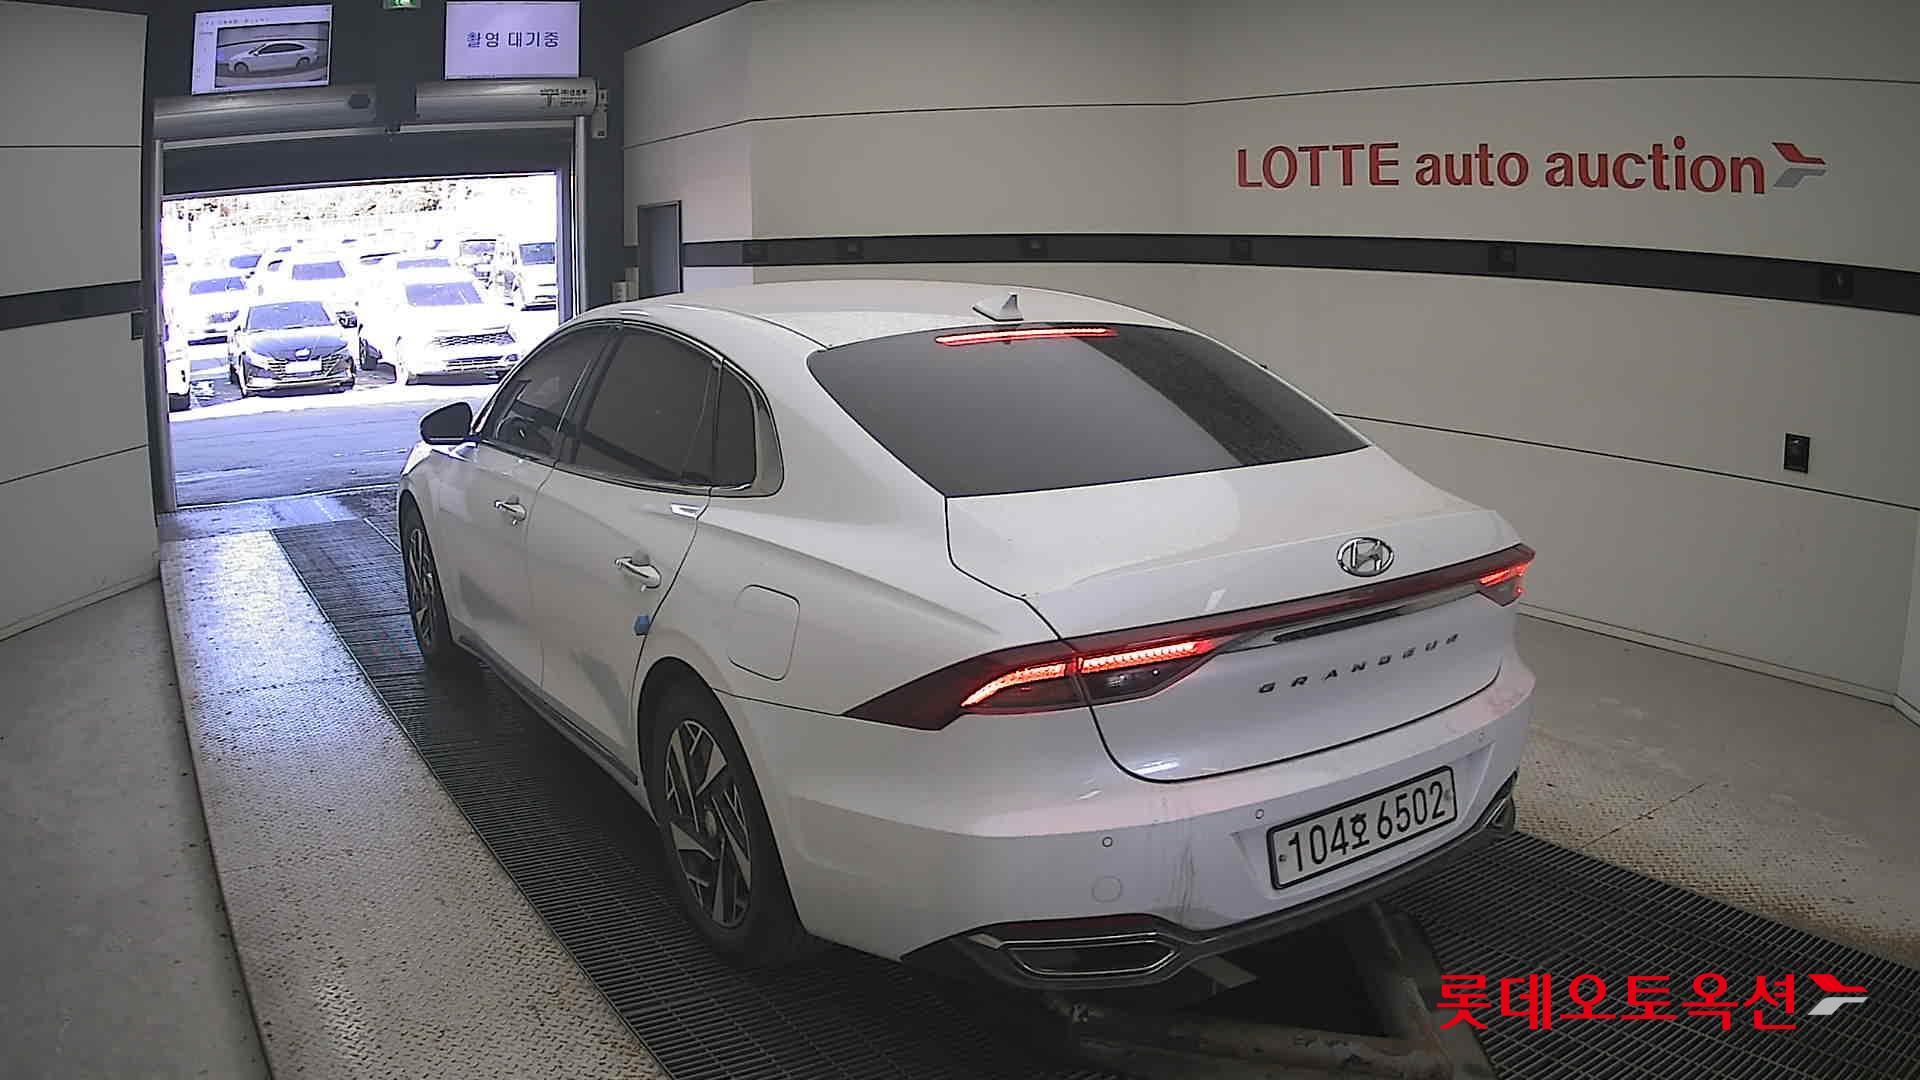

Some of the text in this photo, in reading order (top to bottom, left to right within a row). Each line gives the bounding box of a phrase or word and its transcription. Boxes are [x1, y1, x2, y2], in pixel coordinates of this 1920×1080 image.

[507, 31, 560, 48] 대기중
[1237, 135, 1767, 194] LOTTE auto auction
[1257, 633, 1459, 694] GRANDEUR
[1288, 780, 1446, 872] 104호 6502
